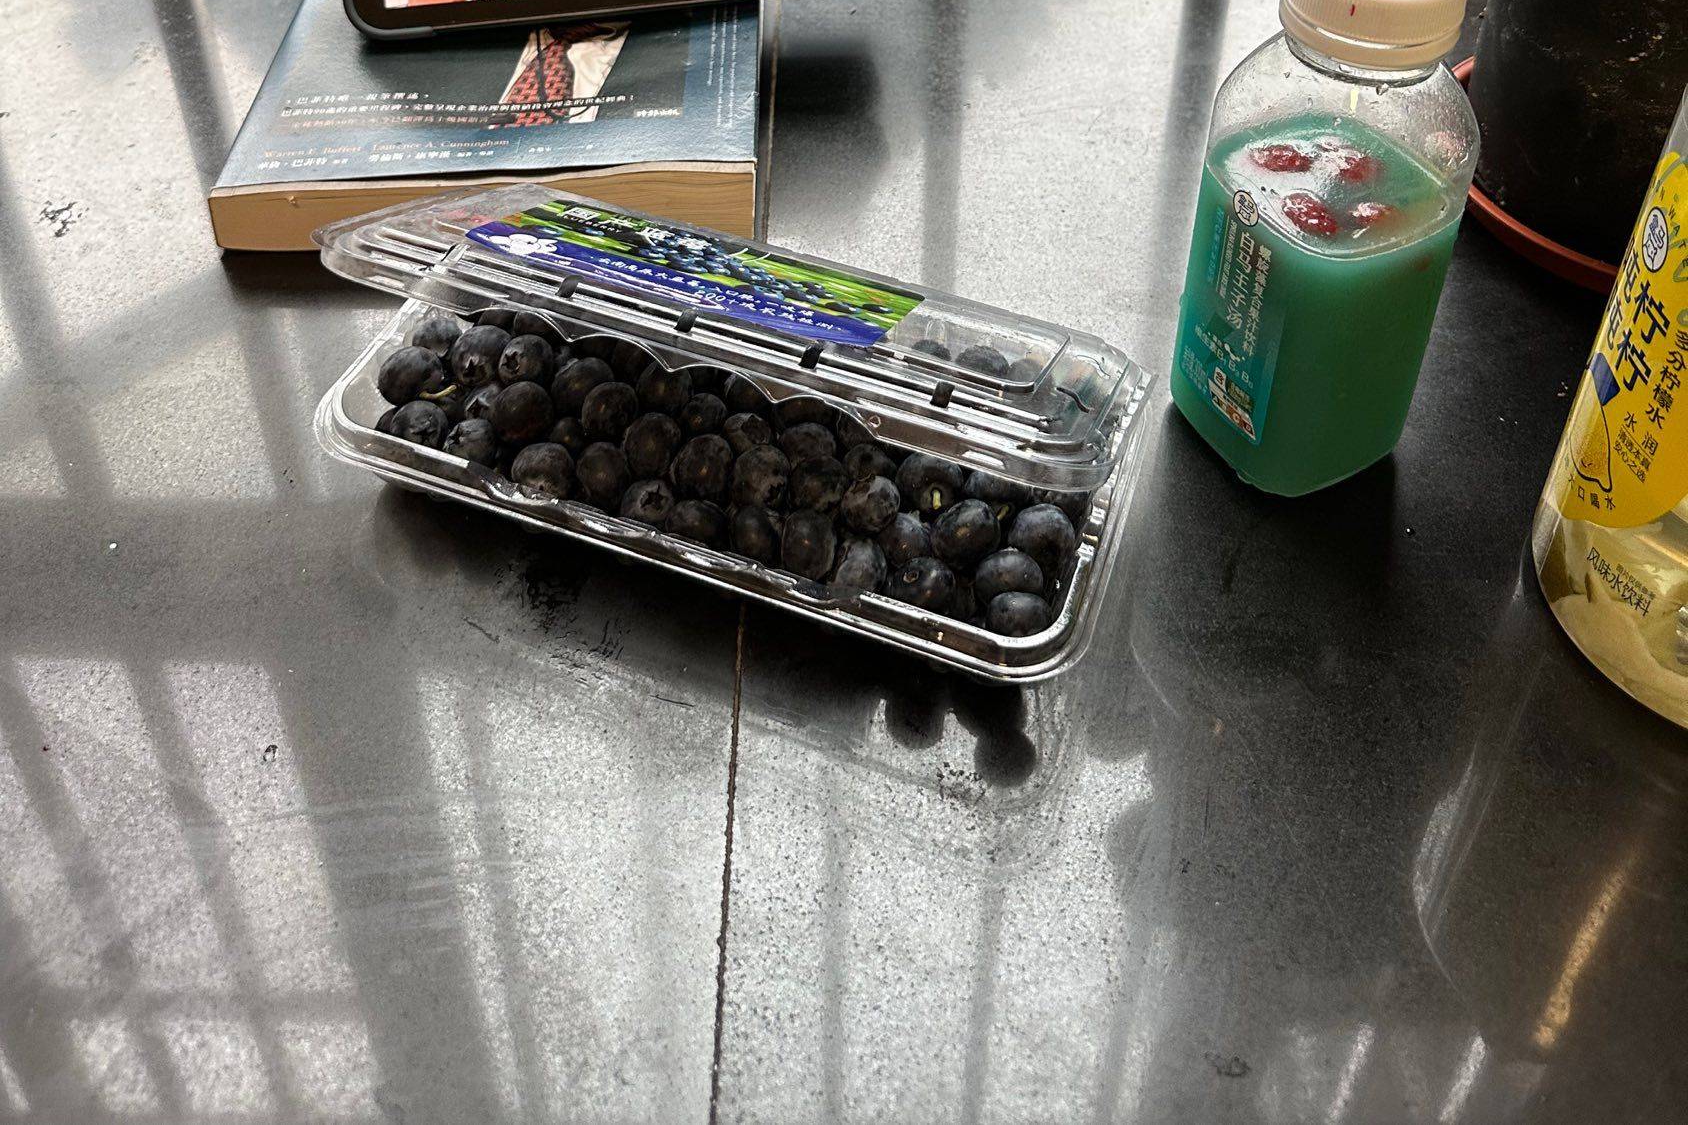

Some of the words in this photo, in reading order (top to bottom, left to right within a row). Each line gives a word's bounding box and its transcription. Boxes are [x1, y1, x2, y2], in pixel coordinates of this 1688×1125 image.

[440, 137, 510, 149] Cunningham
[1586, 546, 1651, 618] 风味水饮料
